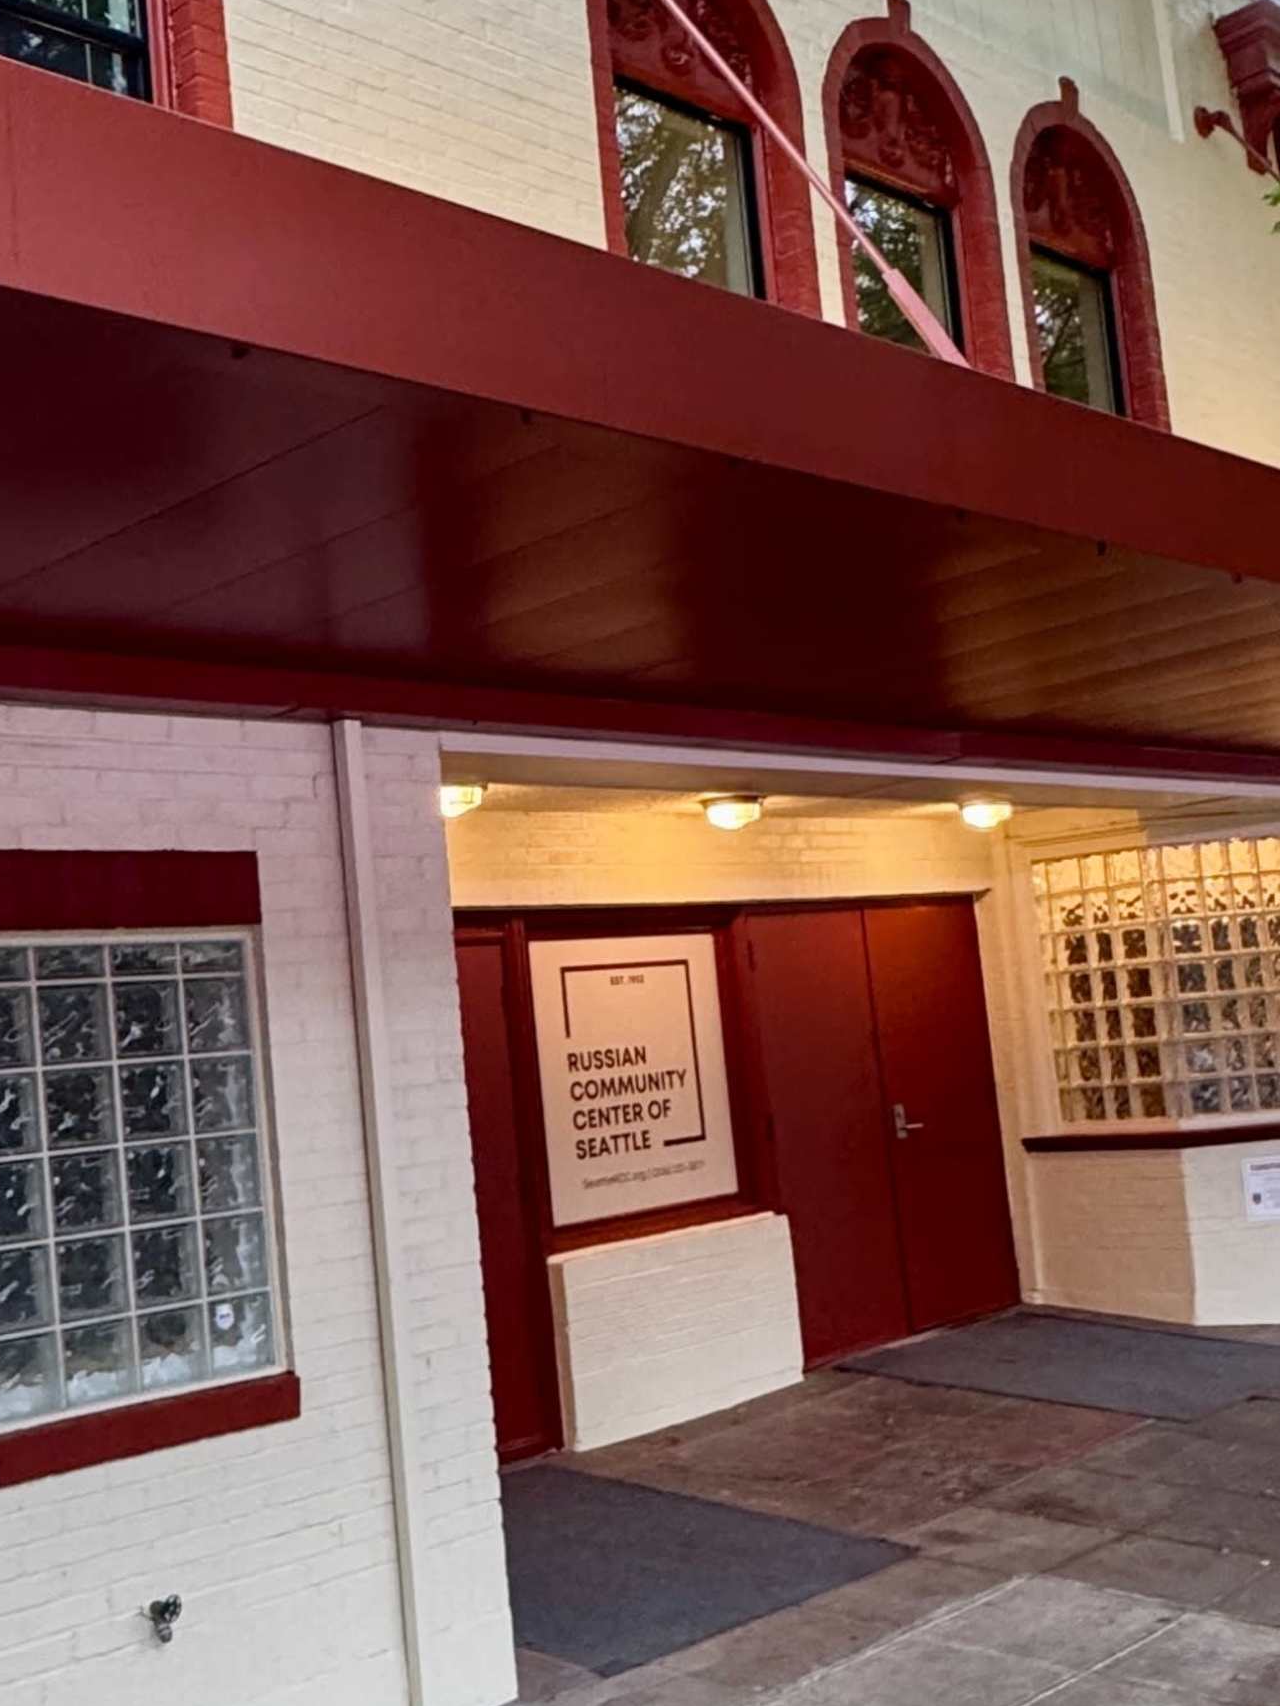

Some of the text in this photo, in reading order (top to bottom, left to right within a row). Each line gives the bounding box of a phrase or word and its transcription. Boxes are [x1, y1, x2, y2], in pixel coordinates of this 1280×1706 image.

[567, 1045, 647, 1072] RUSSIAN
[570, 1068, 687, 1101] COMMUNITY
[573, 1099, 671, 1130] CENTER OF
[576, 1129, 652, 1160] SEATTLE
